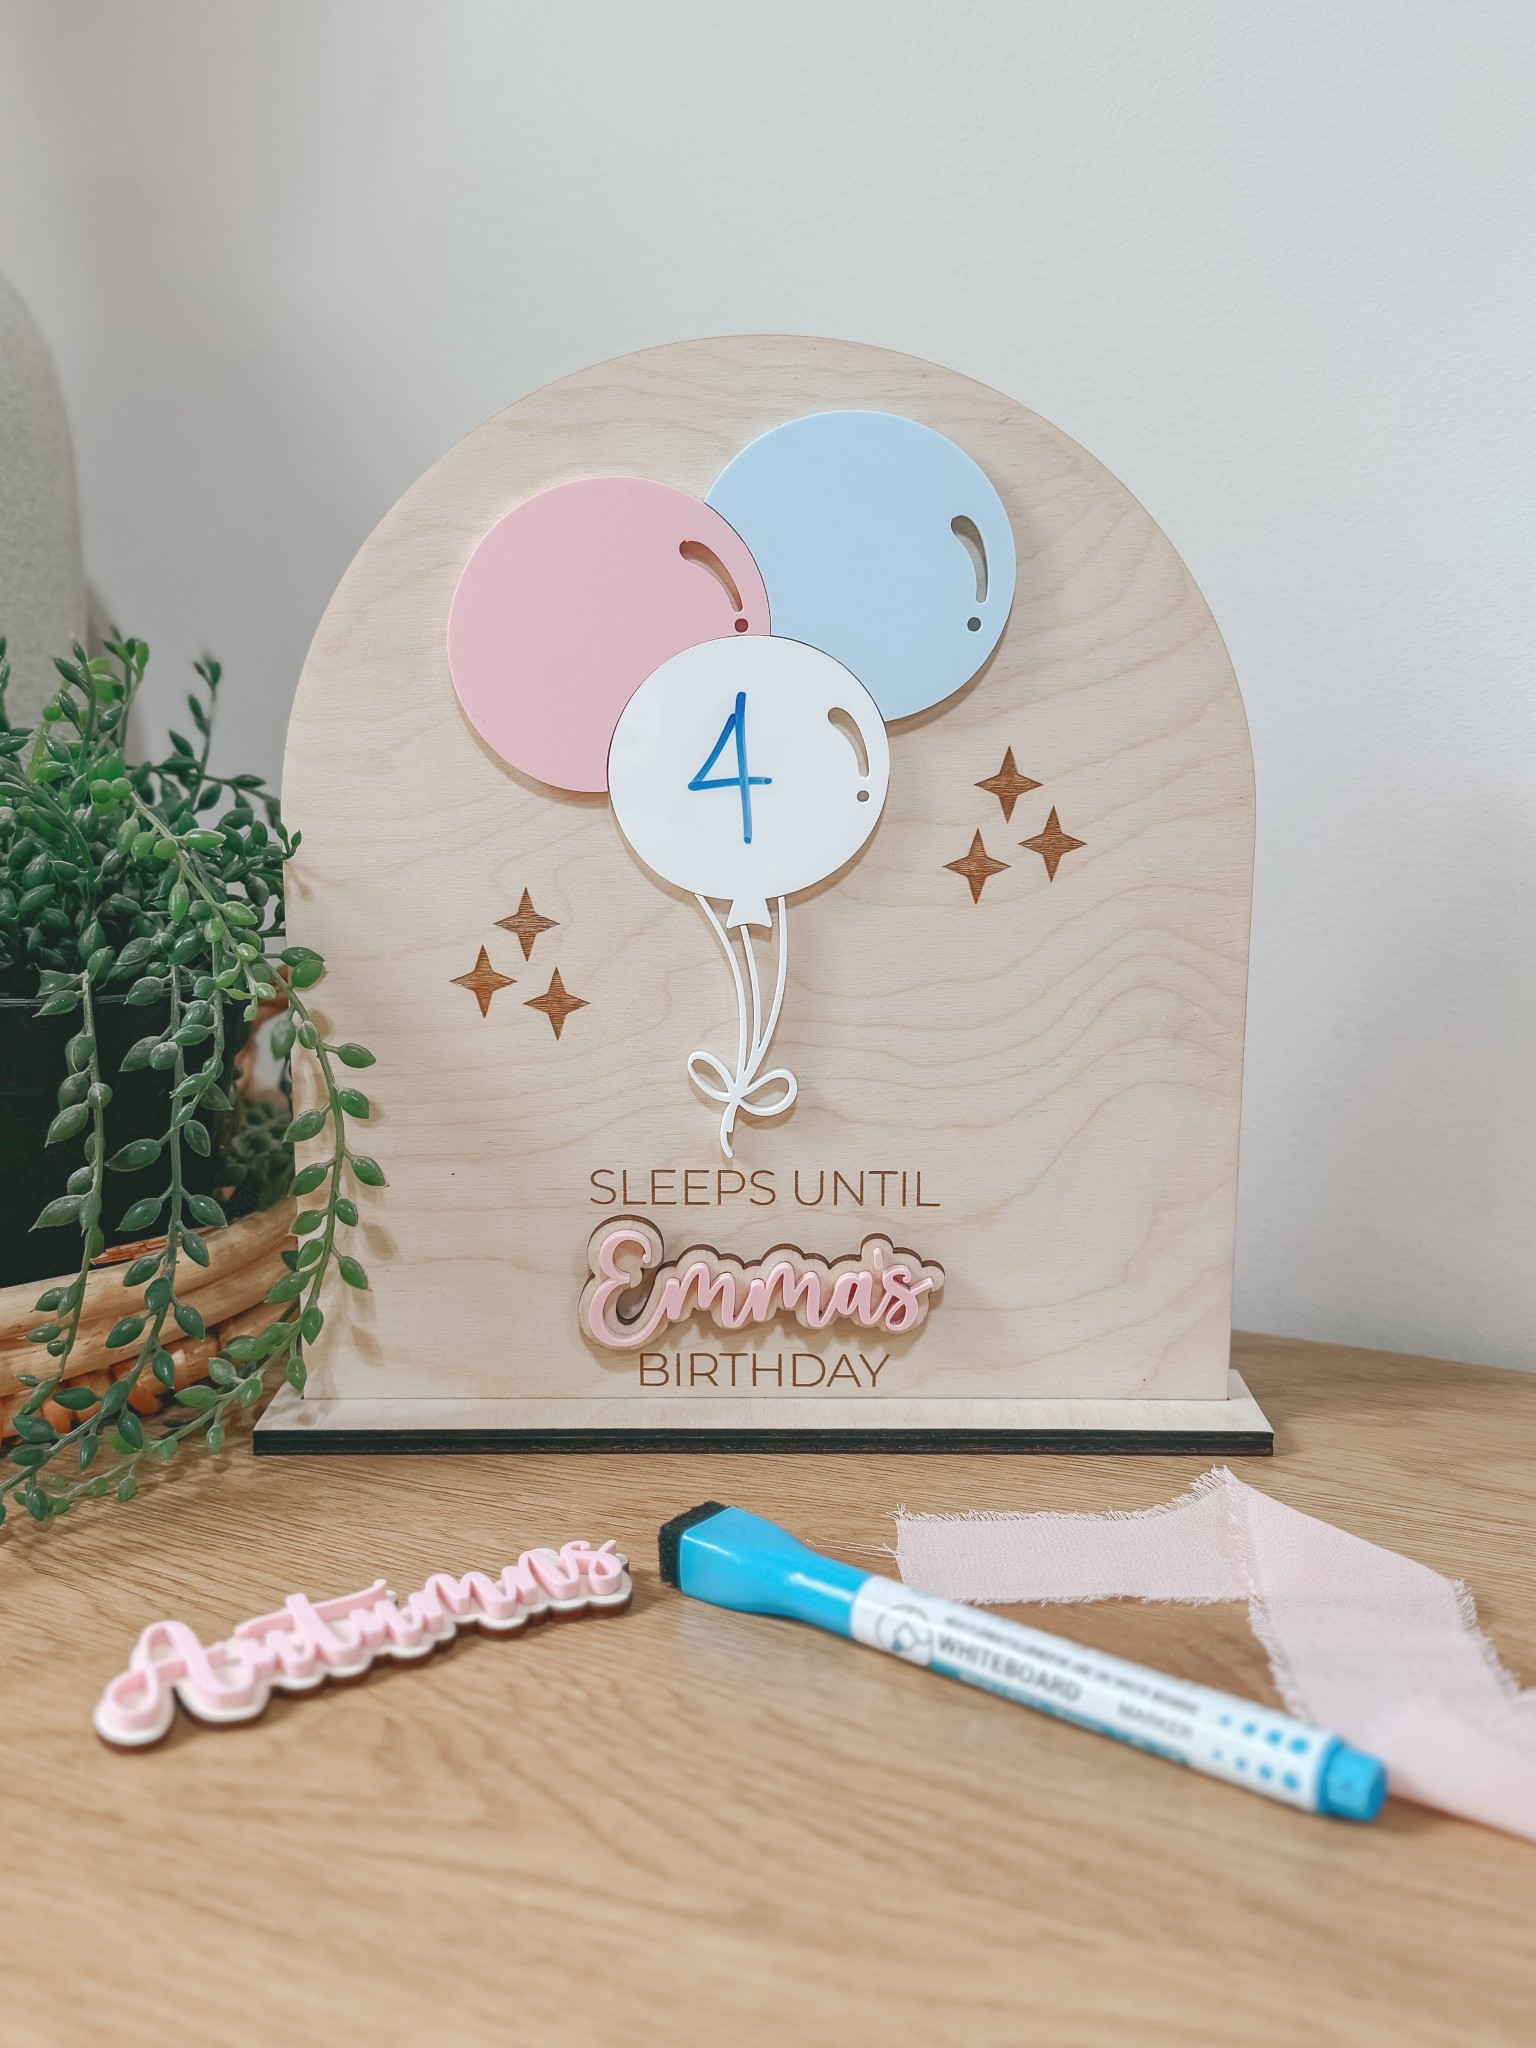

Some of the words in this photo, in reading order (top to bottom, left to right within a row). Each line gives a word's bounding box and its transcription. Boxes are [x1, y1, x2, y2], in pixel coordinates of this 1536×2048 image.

[687, 691, 773, 844] 4
[589, 1169, 777, 1206] SLEEPS
[794, 1170, 941, 1207] UNTIL
[588, 1229, 934, 1348] Emma's
[639, 1352, 890, 1388] BIRTHDAY
[937, 1633, 1083, 1702] WHITEBOARD
